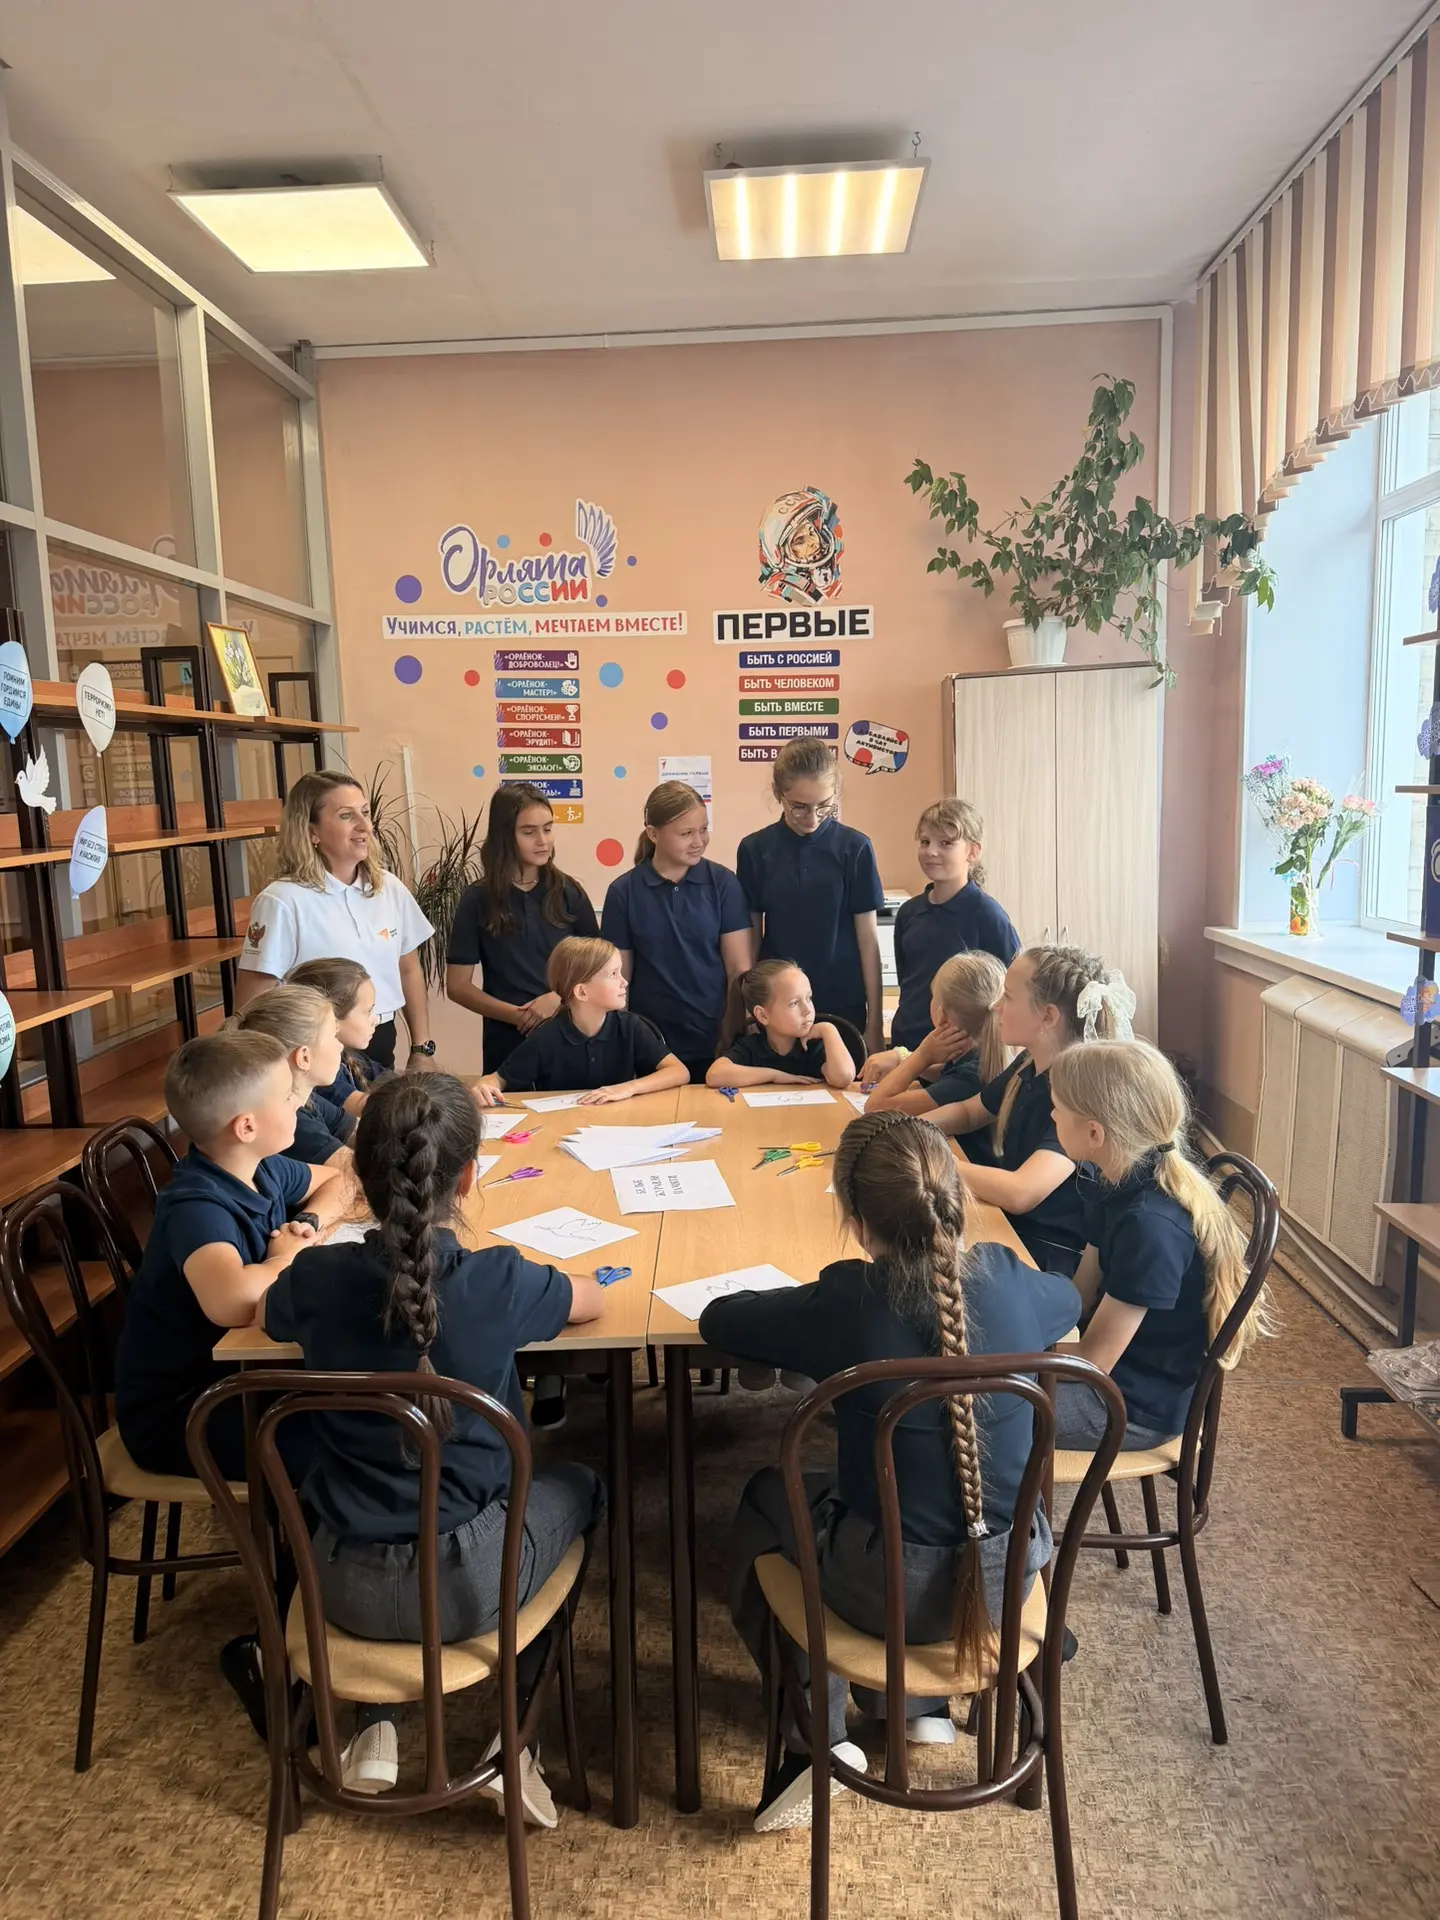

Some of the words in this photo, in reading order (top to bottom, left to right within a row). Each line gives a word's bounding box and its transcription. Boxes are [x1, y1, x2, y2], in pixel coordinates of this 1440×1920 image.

[440, 526, 588, 598] Орлята
[483, 578, 588, 606] РОССИИ
[465, 617, 532, 636] РАСТЁМ,
[535, 618, 610, 633] МЕЧТАЕМ
[615, 612, 683, 632] ВМЕСТЕ!
[717, 608, 870, 641] ПЕРВЫЕ
[747, 655, 775, 665] БЫТЬ
[777, 654, 784, 664] С
[786, 651, 832, 664] РОССИЕЙ
[744, 679, 772, 689] БЫТЬ
[774, 678, 834, 689] ЧЕЛОВЕКОМ
[754, 702, 782, 712] БЫТЬ
[784, 702, 824, 712] ВМЕСТЕ
[748, 726, 776, 737] БЫТЬ
[779, 726, 829, 737] ПЕРВЫМИ
[741, 749, 768, 759] БЫТЬ
